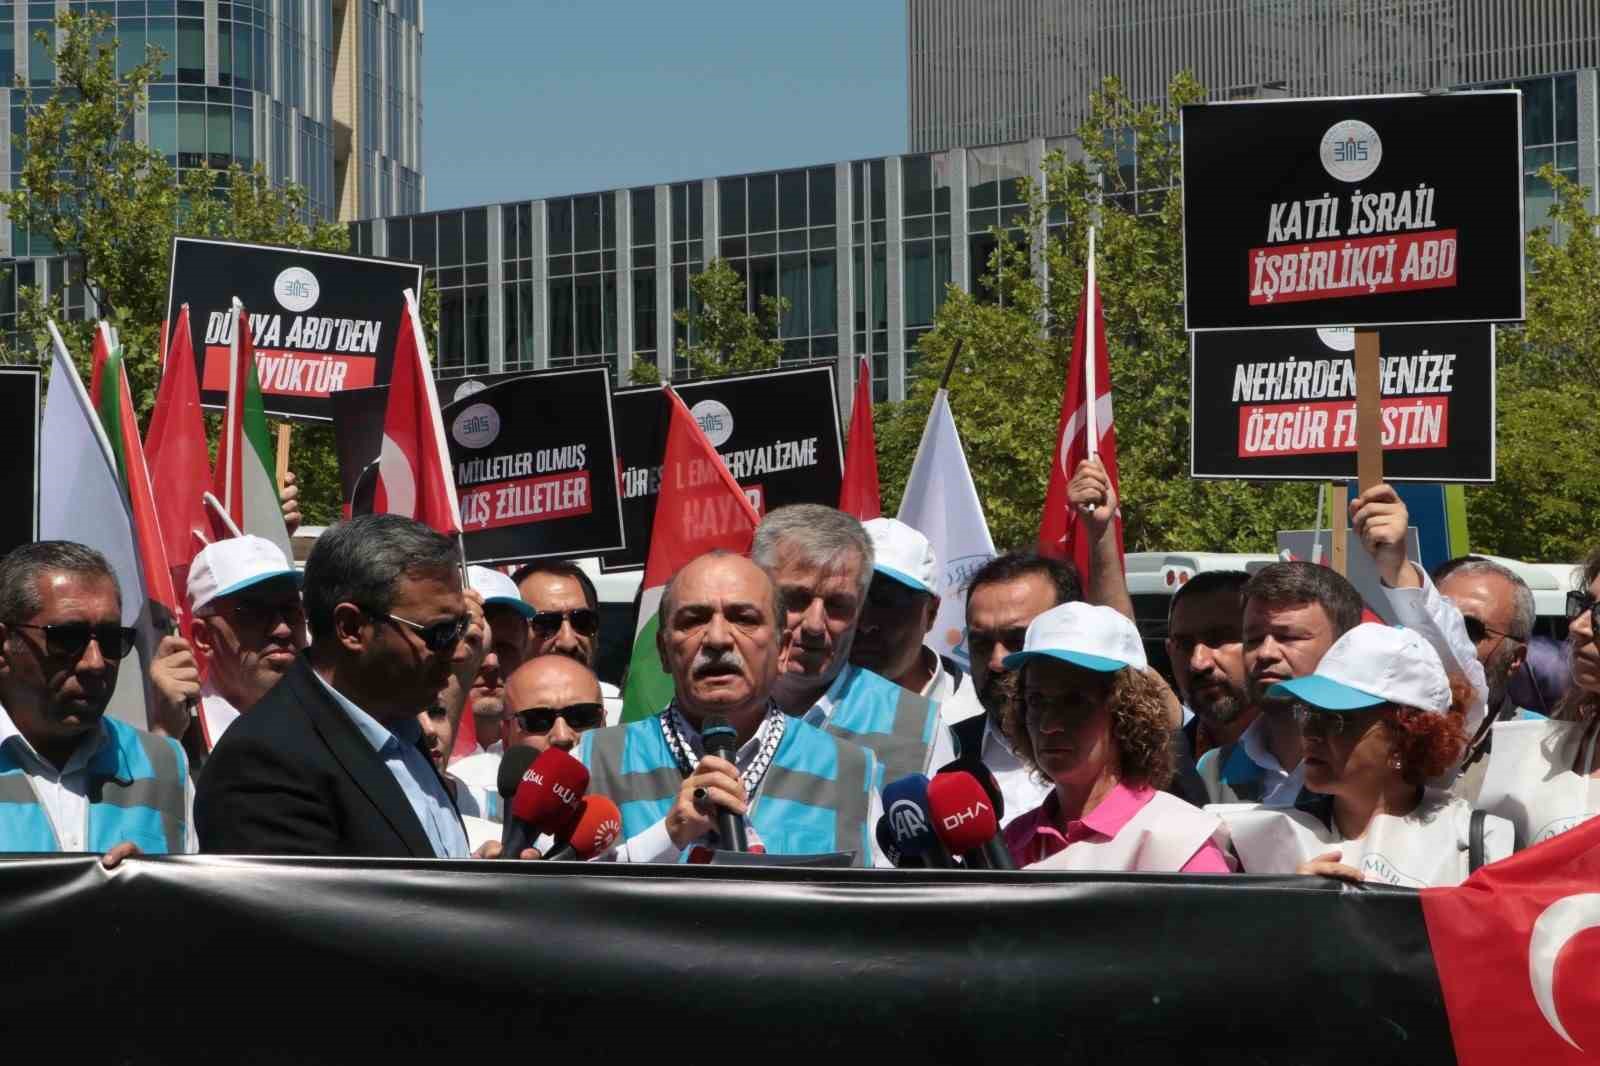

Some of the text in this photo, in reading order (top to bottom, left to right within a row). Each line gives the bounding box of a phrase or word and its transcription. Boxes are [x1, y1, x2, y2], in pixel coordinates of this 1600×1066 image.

[1267, 183, 1437, 243] KATİL İSRAİL
[1251, 238, 1457, 302] İŞBİRLİKÇİ ABD
[205, 308, 381, 353] DÜYA ABD'DEN
[1232, 356, 1357, 402] NEHİRDEN
[1245, 401, 1443, 453] ÖZGÜR FİSTİN
[459, 445, 586, 485] MİLLETLER OLMUŞ
[495, 477, 587, 520] ZİLLETLER
[943, 801, 989, 831] DHA
